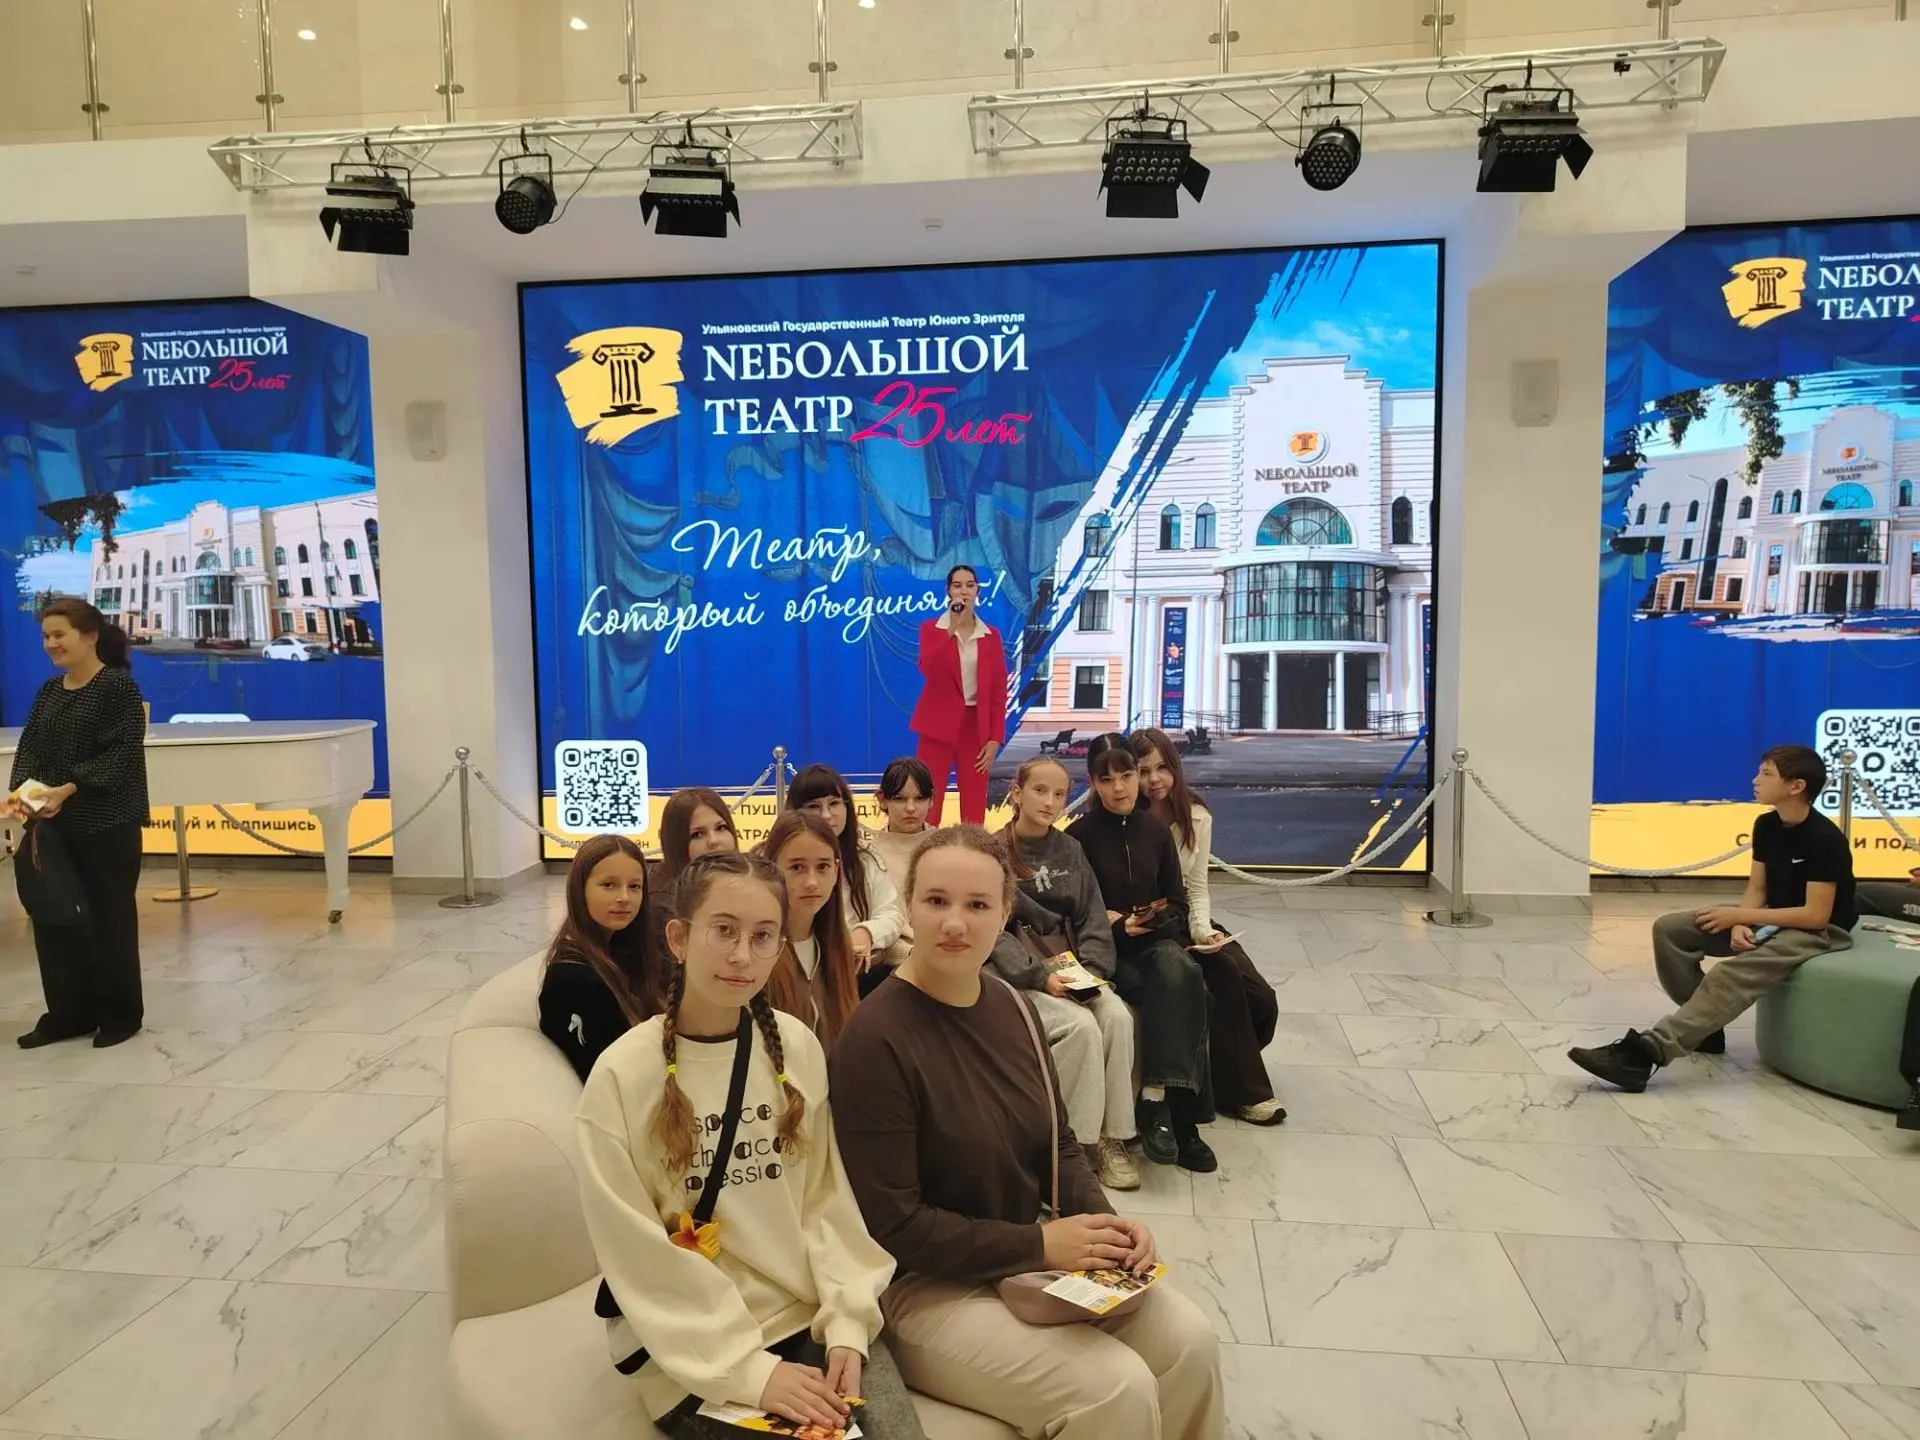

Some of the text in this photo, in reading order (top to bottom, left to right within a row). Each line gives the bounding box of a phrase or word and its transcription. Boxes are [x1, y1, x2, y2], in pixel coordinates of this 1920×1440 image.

[1816, 295, 1915, 320] ТЕАТР
[702, 313, 1025, 334] Ульяновский Государственный Театр Юного Зрителя
[143, 366, 211, 387] ТЕАТР
[704, 395, 853, 435] ТЕАТР
[1281, 481, 1332, 495] ТЕАТР
[671, 519, 882, 582] Театр,
[577, 585, 765, 654] который
[206, 819, 216, 830] и
[1854, 837, 1866, 849] и
